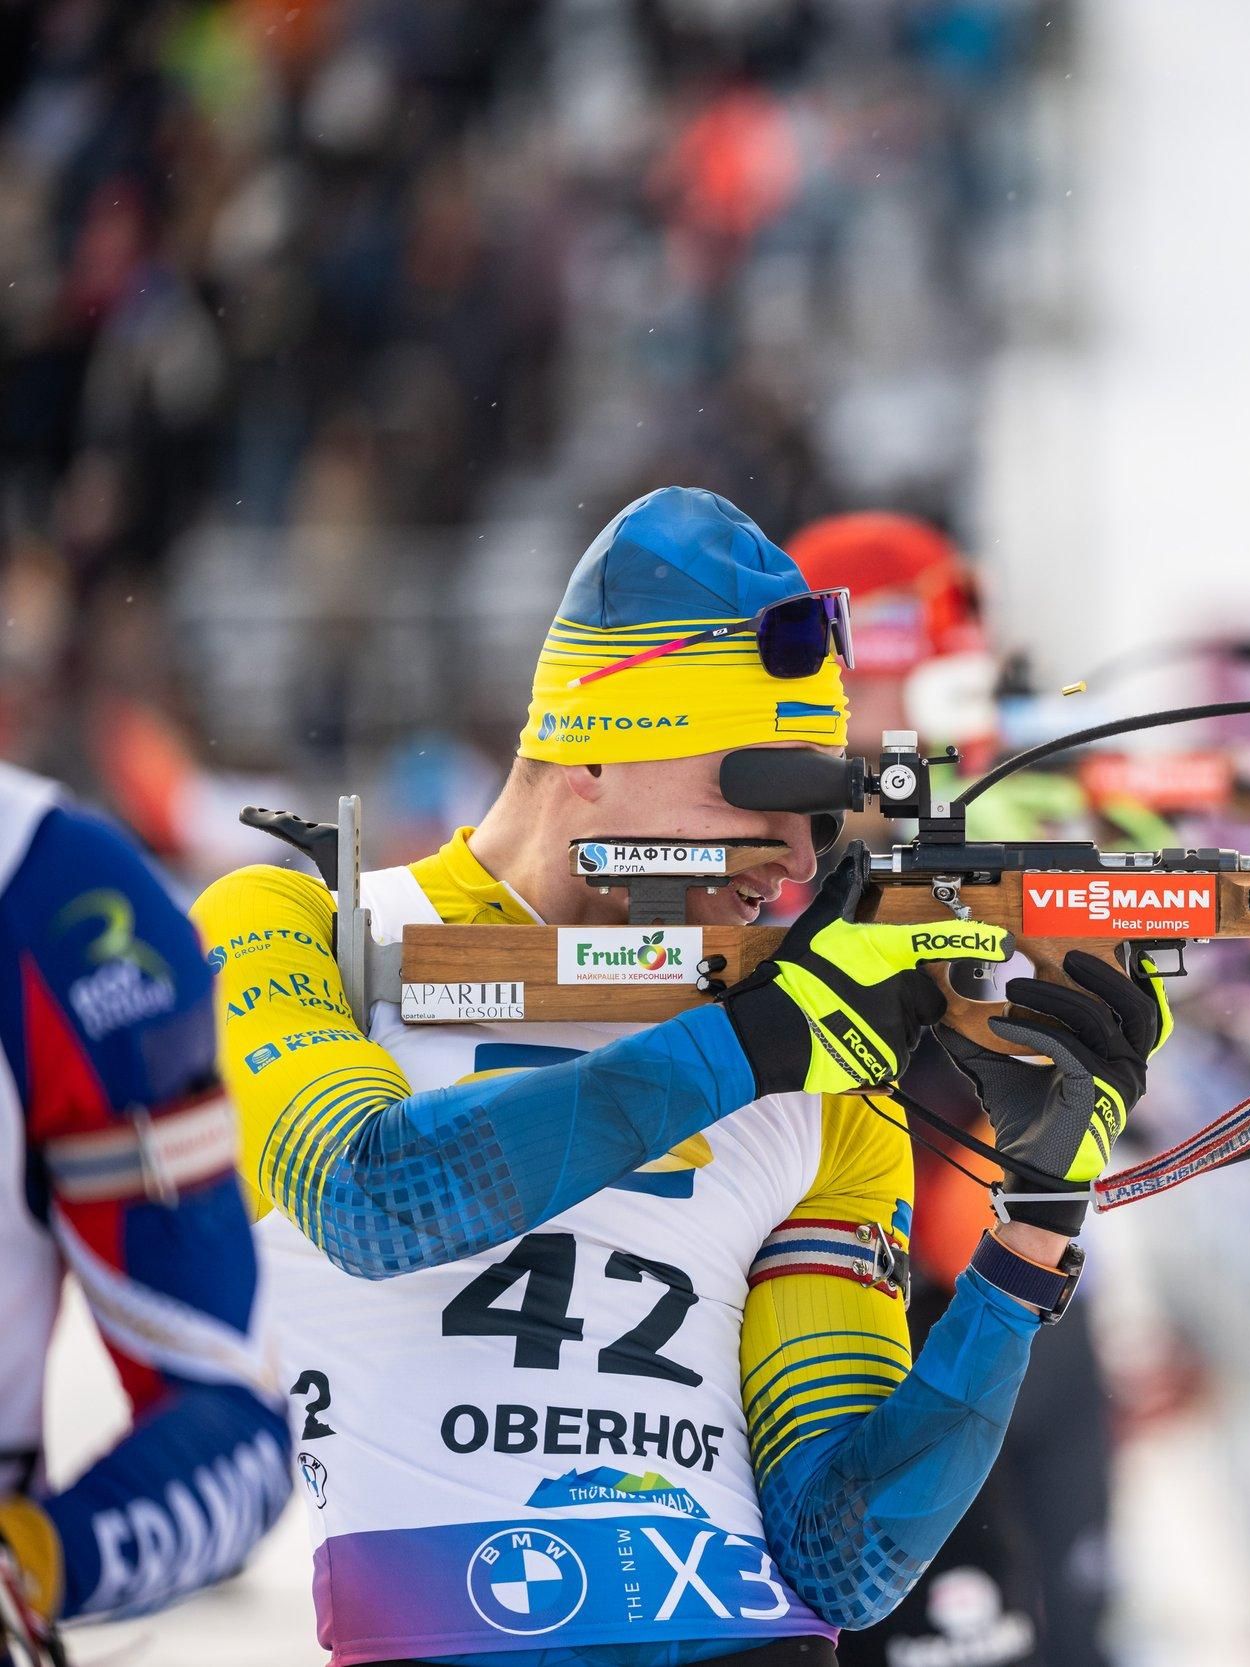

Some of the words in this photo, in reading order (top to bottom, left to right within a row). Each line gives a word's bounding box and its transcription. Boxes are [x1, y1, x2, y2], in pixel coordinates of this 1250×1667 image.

[560, 714, 689, 731] NAFTOGAZ
[614, 846, 724, 862] НАФТОГАЗ
[613, 864, 646, 873] ГРУПА
[1027, 880, 1211, 920] VIESSMANN
[1112, 918, 1143, 930] Heat
[1146, 919, 1190, 932] pumps
[229, 929, 335, 963] NAFTO
[234, 943, 272, 959] GROUP
[576, 972, 620, 981] НАЙКРАЩЕ
[628, 973, 684, 981] ХЕРСОНЩИНИ
[401, 983, 524, 1005] APARTEL
[457, 1005, 525, 1019] resorts
[441, 1232, 704, 1388] 42
[440, 1403, 725, 1473] OBERHOF
[479, 1532, 568, 1566] BMW
[615, 1527, 638, 1572] NEW
[639, 1526, 791, 1623] X3
[624, 1580, 644, 1624] THE
